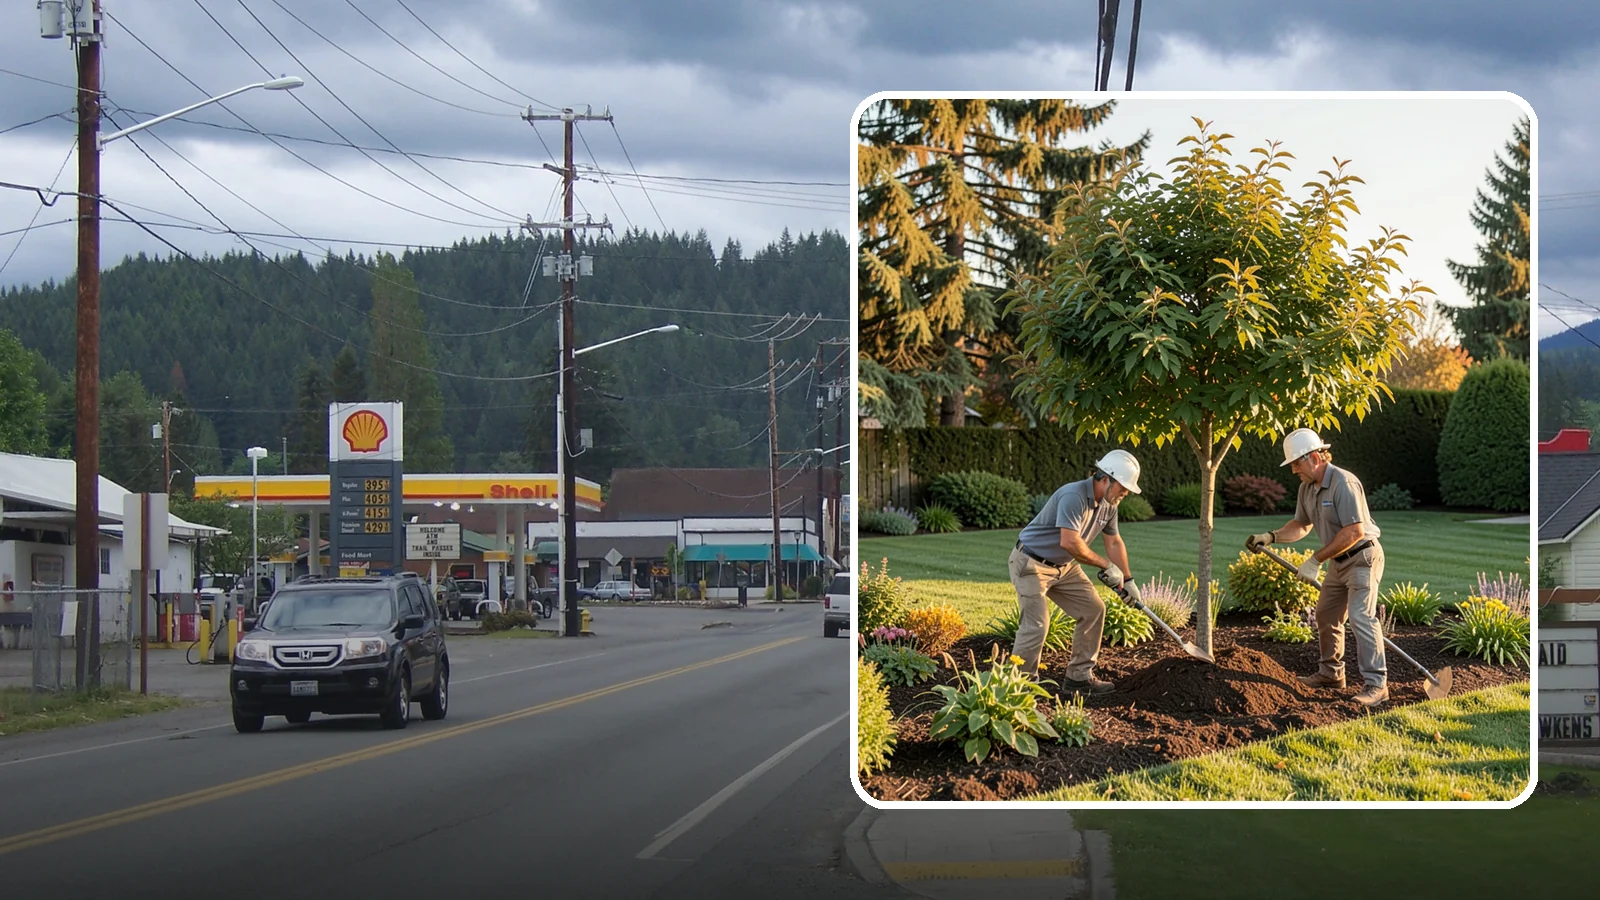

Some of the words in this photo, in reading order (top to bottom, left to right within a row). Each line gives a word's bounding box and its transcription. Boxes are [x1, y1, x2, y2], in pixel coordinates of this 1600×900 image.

[366, 480, 383, 490] 395
[490, 484, 547, 499] Shell
[366, 494, 384, 504] 405
[366, 508, 383, 518] 415
[366, 522, 383, 532] 429
